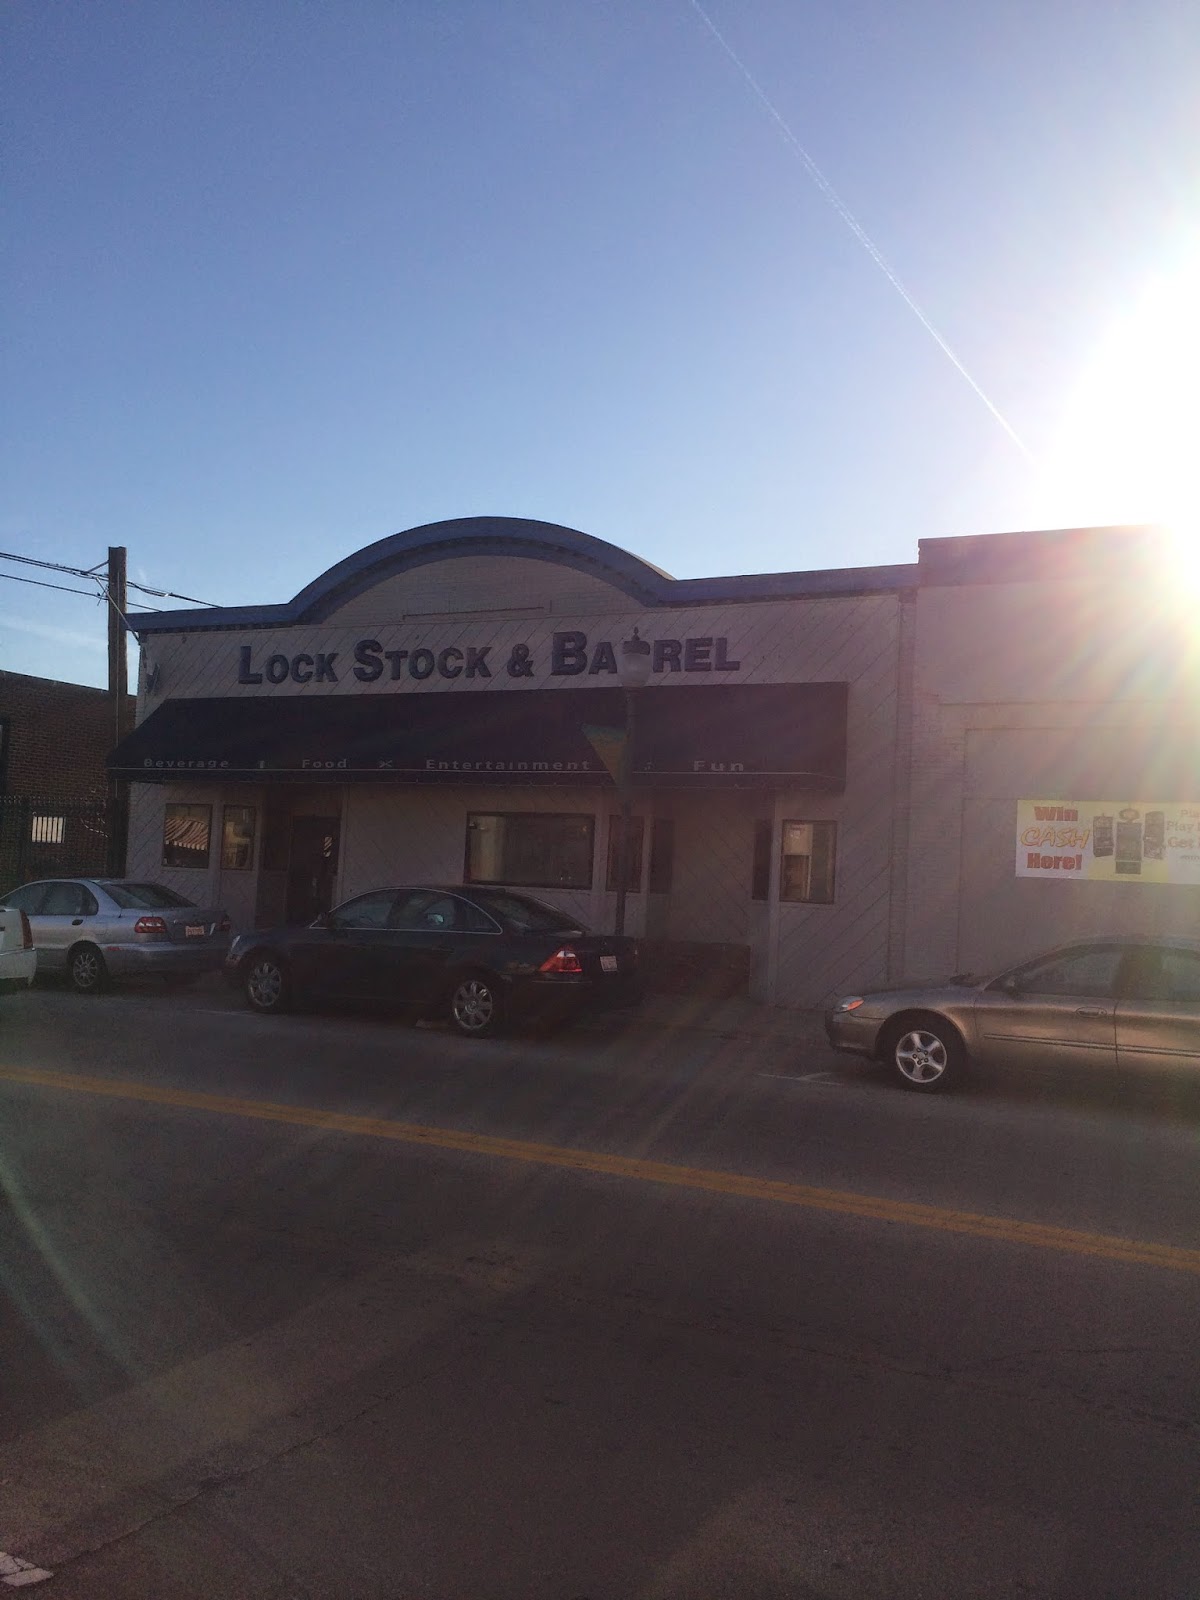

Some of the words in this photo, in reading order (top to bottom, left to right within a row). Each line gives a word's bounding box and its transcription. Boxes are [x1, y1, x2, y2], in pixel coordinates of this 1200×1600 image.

[237, 645, 339, 685] LOCK
[353, 639, 493, 683] STOCK
[507, 643, 535, 678] &
[143, 758, 230, 770] Beverage
[302, 758, 348, 769] Food
[425, 759, 592, 771] Entertainment
[692, 760, 745, 772] Fun
[1033, 805, 1079, 822] Win
[1020, 826, 1091, 849] CASH
[1027, 852, 1083, 871] Here!
